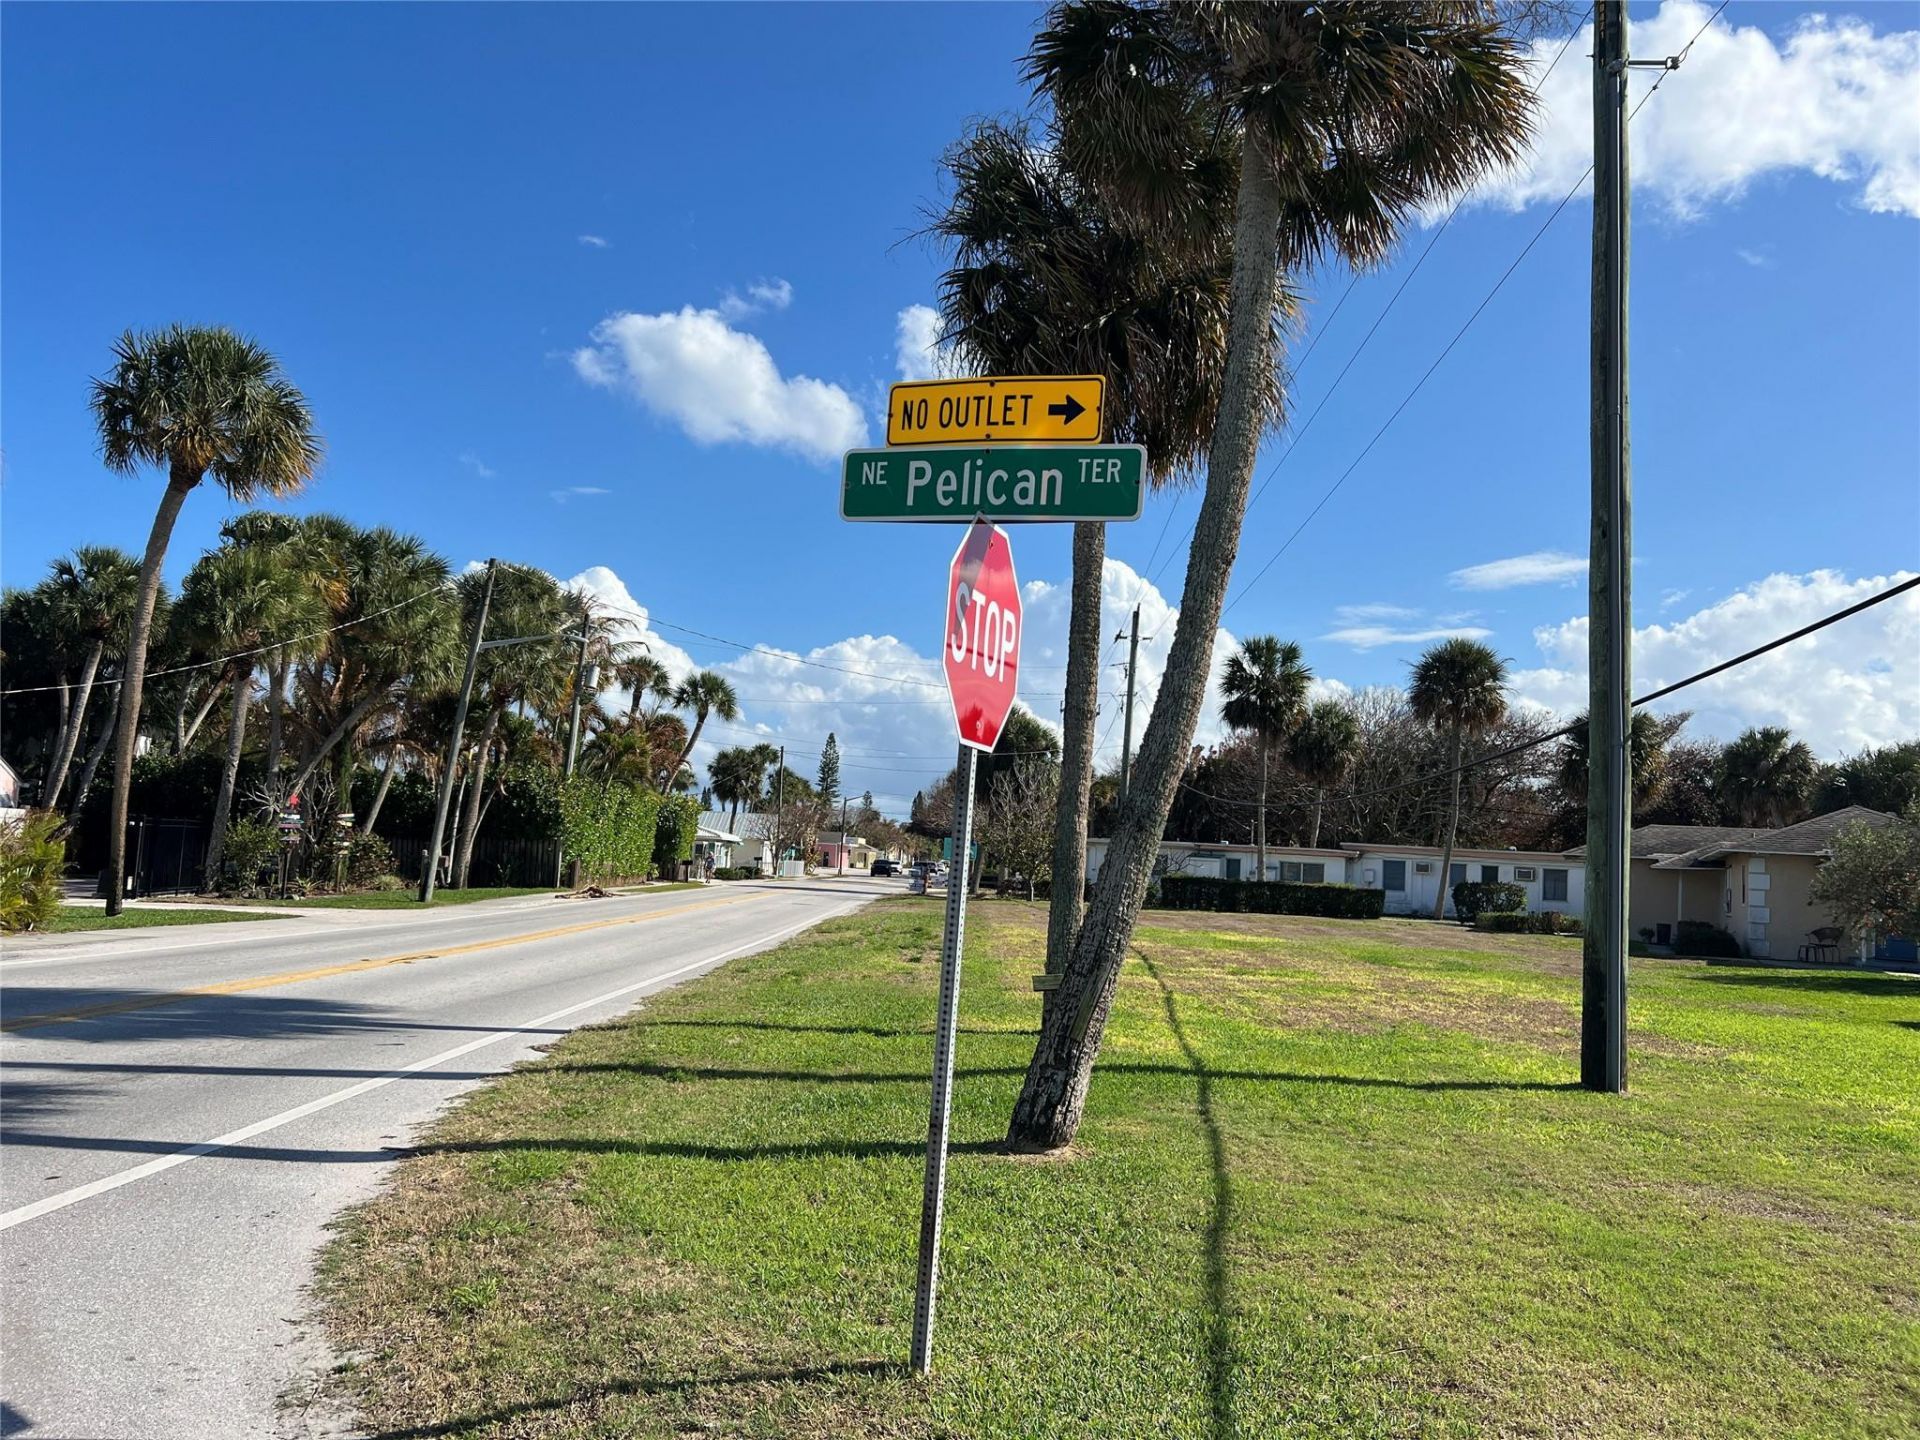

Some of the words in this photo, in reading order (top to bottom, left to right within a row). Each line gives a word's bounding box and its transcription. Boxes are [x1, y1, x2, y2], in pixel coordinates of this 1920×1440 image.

[901, 398, 928, 431] NO
[939, 394, 1033, 429] OUTLET
[861, 461, 888, 485] NE
[906, 458, 1063, 507] Pelican
[1078, 458, 1122, 484] TER
[951, 581, 1016, 684] STOP
